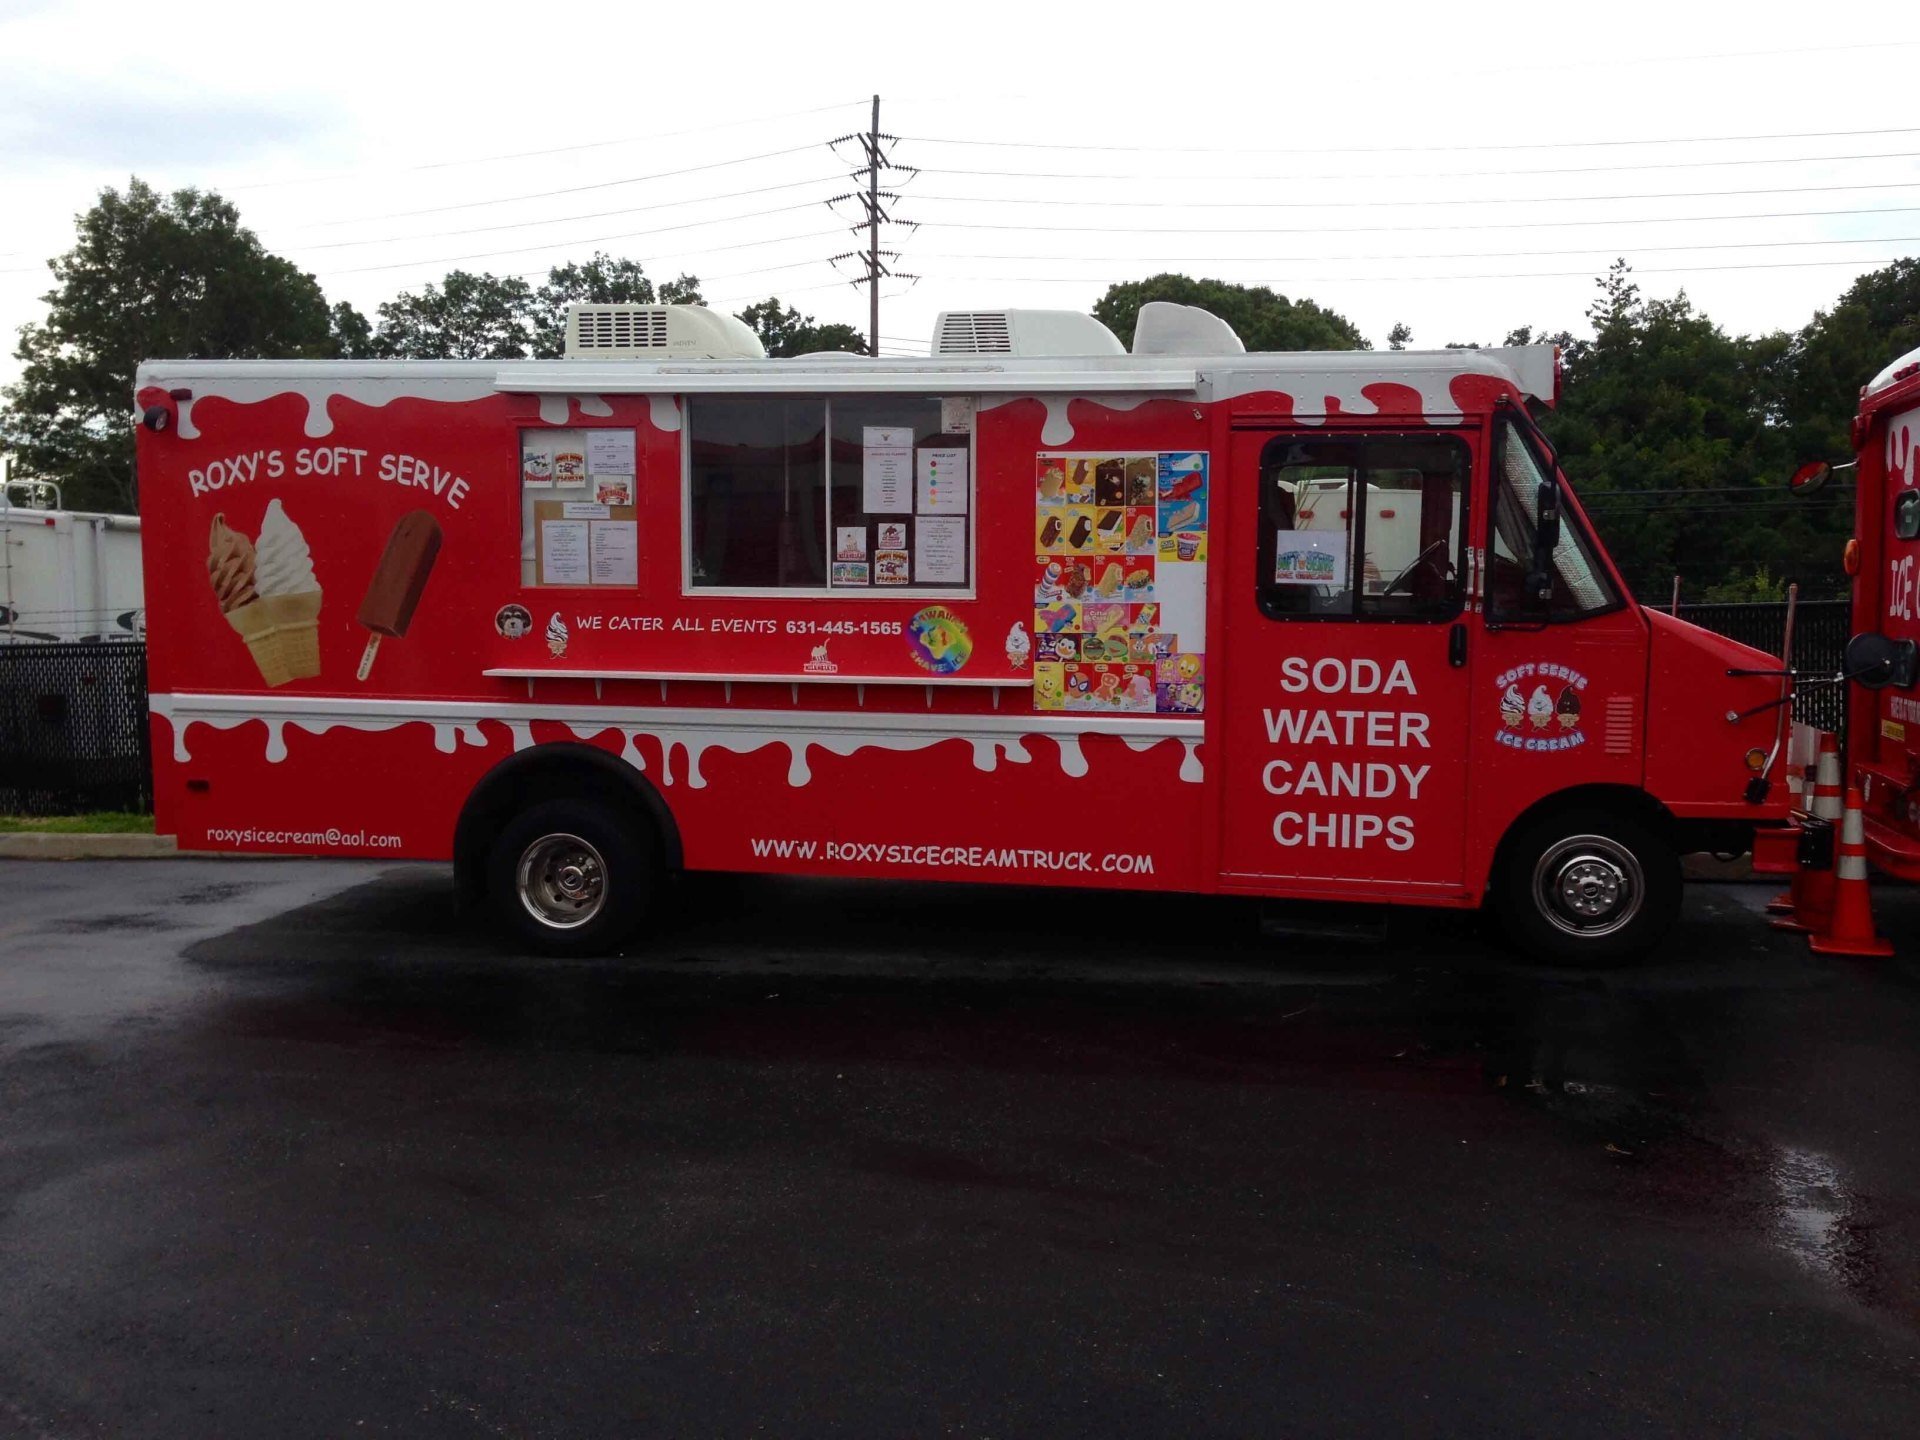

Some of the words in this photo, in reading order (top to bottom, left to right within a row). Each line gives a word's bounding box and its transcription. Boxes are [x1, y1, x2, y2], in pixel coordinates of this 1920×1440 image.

[188, 450, 285, 498] ROXY'S
[295, 446, 368, 477] SOFT
[378, 453, 471, 510] SERVE
[576, 615, 603, 630] WE
[608, 616, 664, 632] CATER
[671, 617, 705, 632] ALL
[710, 618, 777, 634] EVENTS
[785, 620, 902, 635] 631-445-1565
[1279, 656, 1418, 695] SODA
[1495, 662, 1535, 689] SOFT
[1538, 662, 1589, 691] SERVE
[1262, 708, 1431, 748] WATER
[1495, 730, 1523, 748] ICE
[1525, 730, 1586, 751] CREAM
[1262, 759, 1432, 800] CANDY
[207, 827, 402, 848] roxysicecream@aol.com
[1272, 811, 1415, 852] CHIPS
[750, 838, 1155, 875] WWW.ROXYSICECREAMTRUCK.COM
